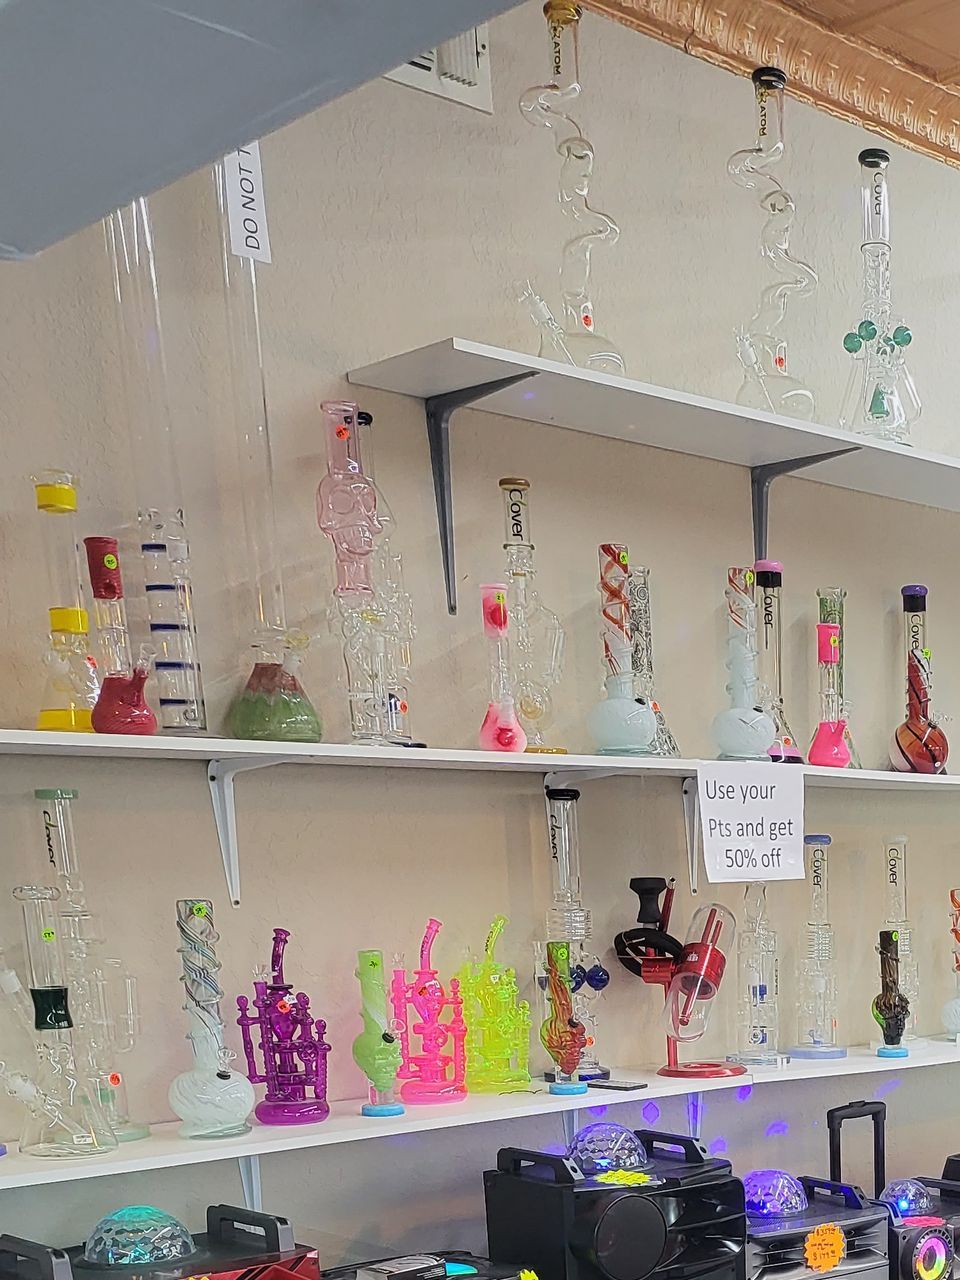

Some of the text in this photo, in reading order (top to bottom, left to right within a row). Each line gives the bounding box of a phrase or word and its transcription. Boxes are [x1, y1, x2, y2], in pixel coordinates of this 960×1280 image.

[238, 162, 256, 211] NOT
[243, 218, 260, 250] DO
[705, 780, 776, 804] Use your
[708, 817, 793, 841] Pts and get
[725, 848, 781, 868] 50% off
